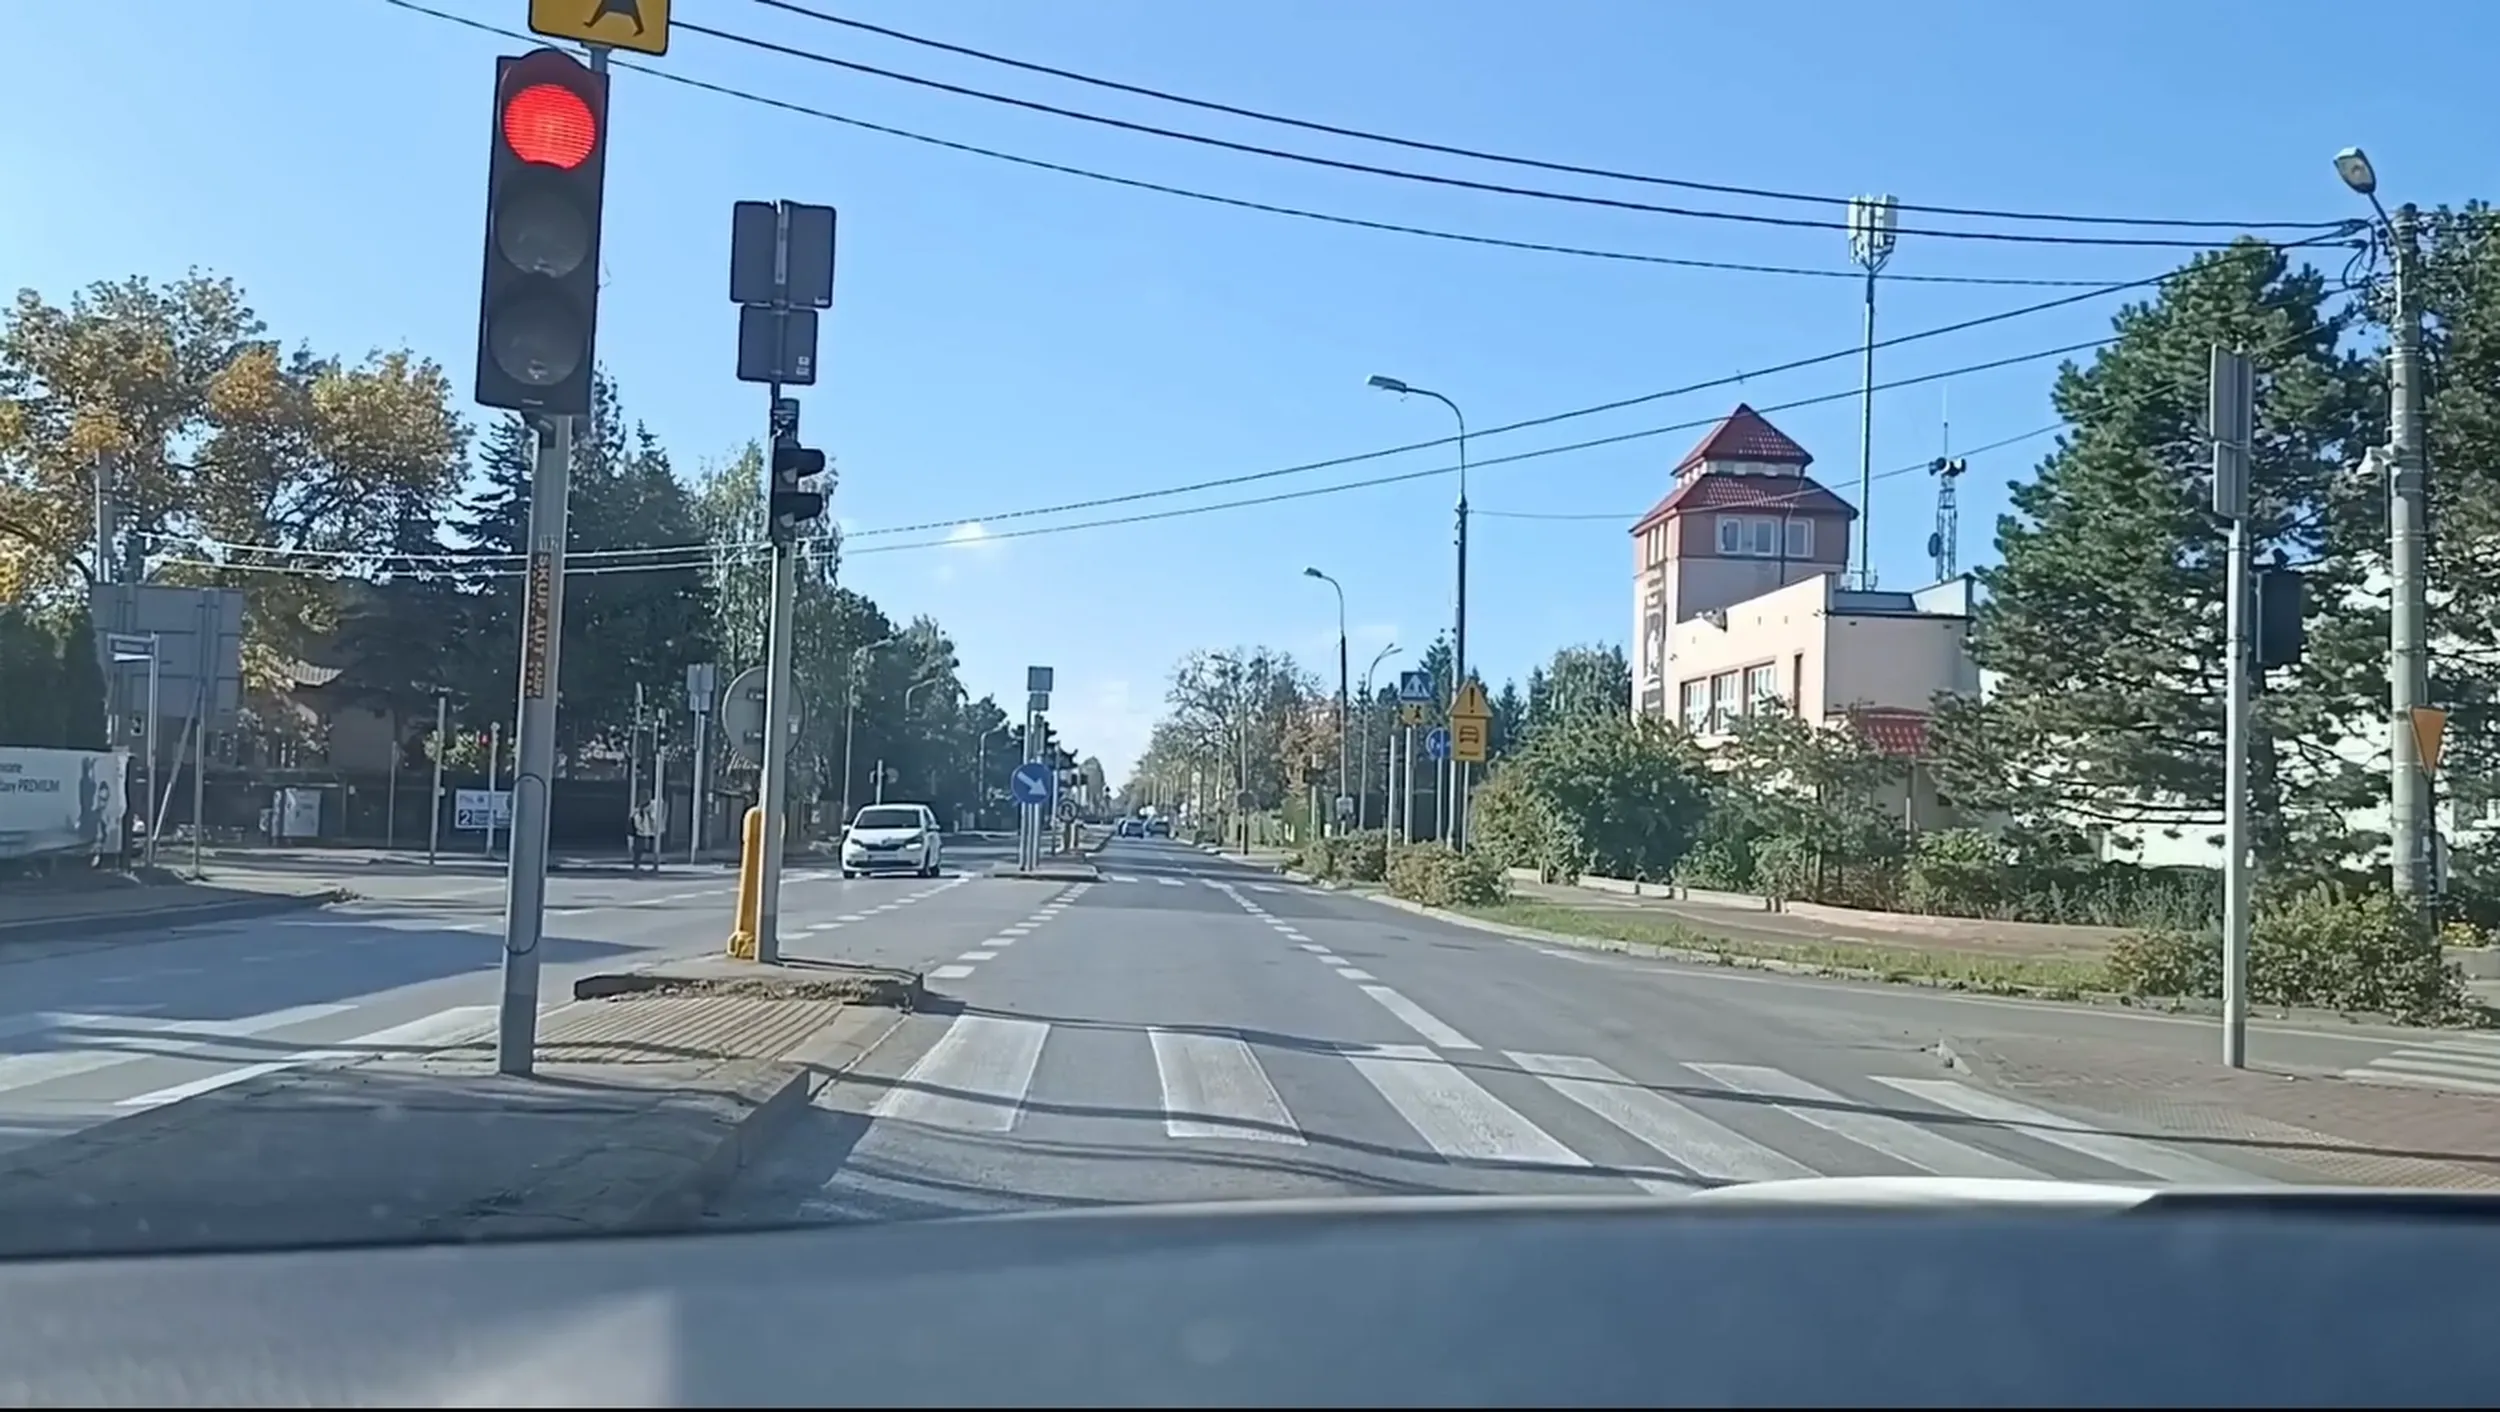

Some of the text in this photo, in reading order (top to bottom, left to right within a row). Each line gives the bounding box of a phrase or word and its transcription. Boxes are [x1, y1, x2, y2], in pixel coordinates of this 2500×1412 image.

[536, 554, 549, 609] SKUP
[533, 615, 547, 657] AUT
[460, 810, 471, 825] 2
